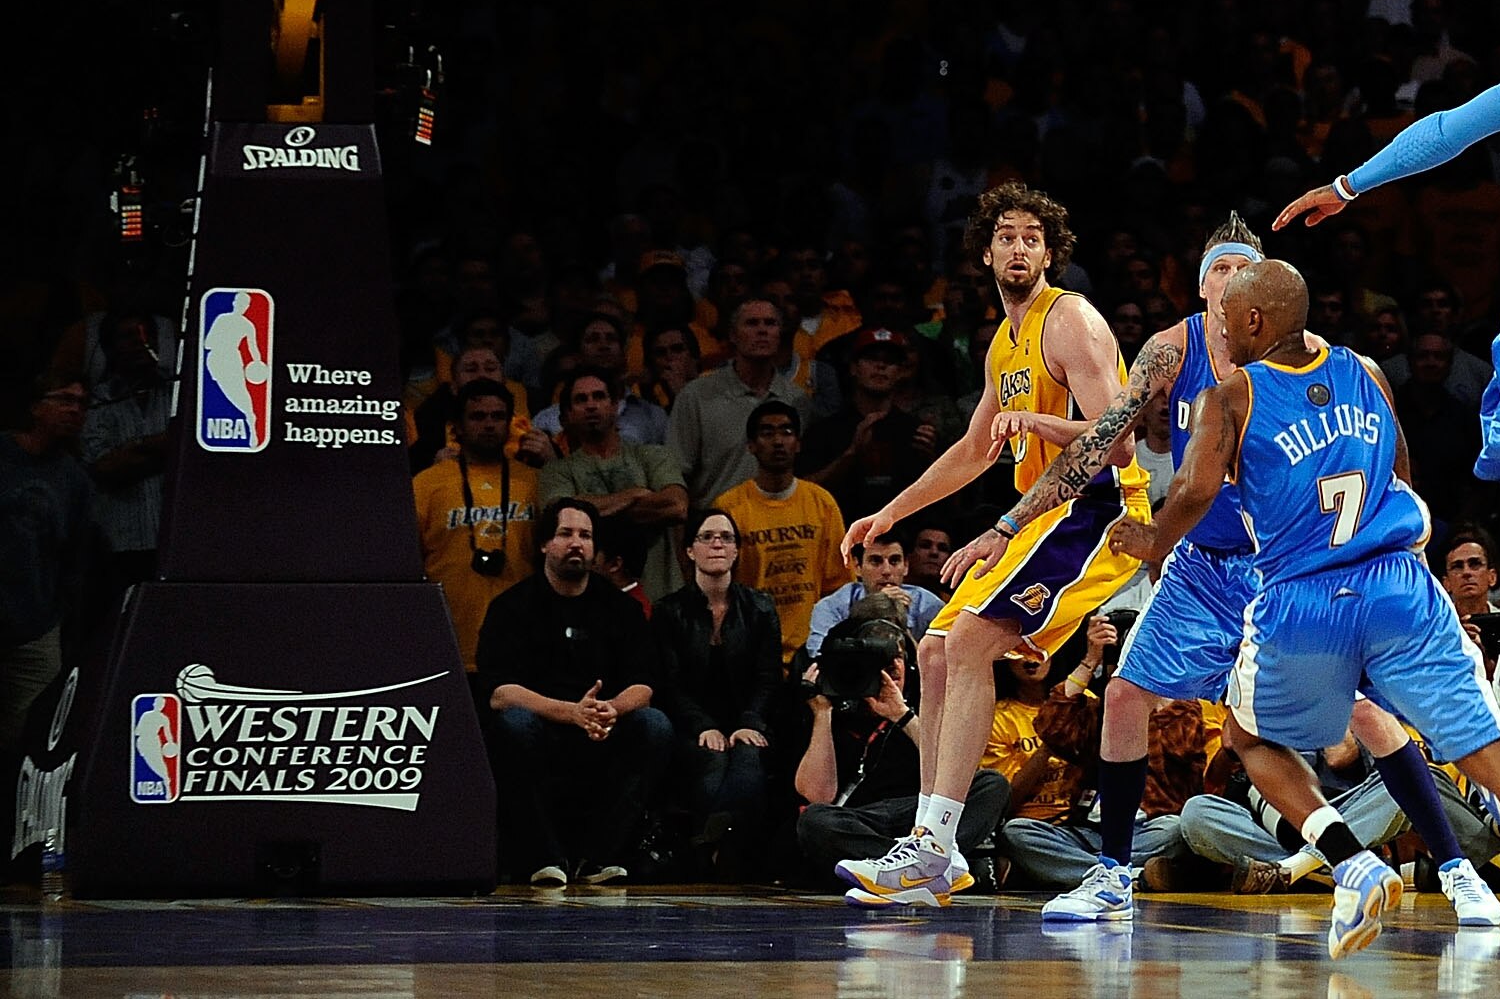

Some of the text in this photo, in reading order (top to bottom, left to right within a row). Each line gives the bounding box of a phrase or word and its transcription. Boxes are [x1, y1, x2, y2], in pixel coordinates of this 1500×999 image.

[243, 145, 361, 171] SPALDING
[286, 363, 372, 386] Where
[284, 395, 400, 420] amazing
[206, 418, 247, 440] NBA
[284, 422, 401, 448] happens.
[1273, 404, 1380, 466] BILLUPS
[1317, 470, 1367, 549] 7
[185, 705, 440, 743] WESTERN
[186, 745, 428, 766] CONFERENCE
[137, 781, 165, 796] NBA
[183, 767, 423, 792] FINALS 2009
